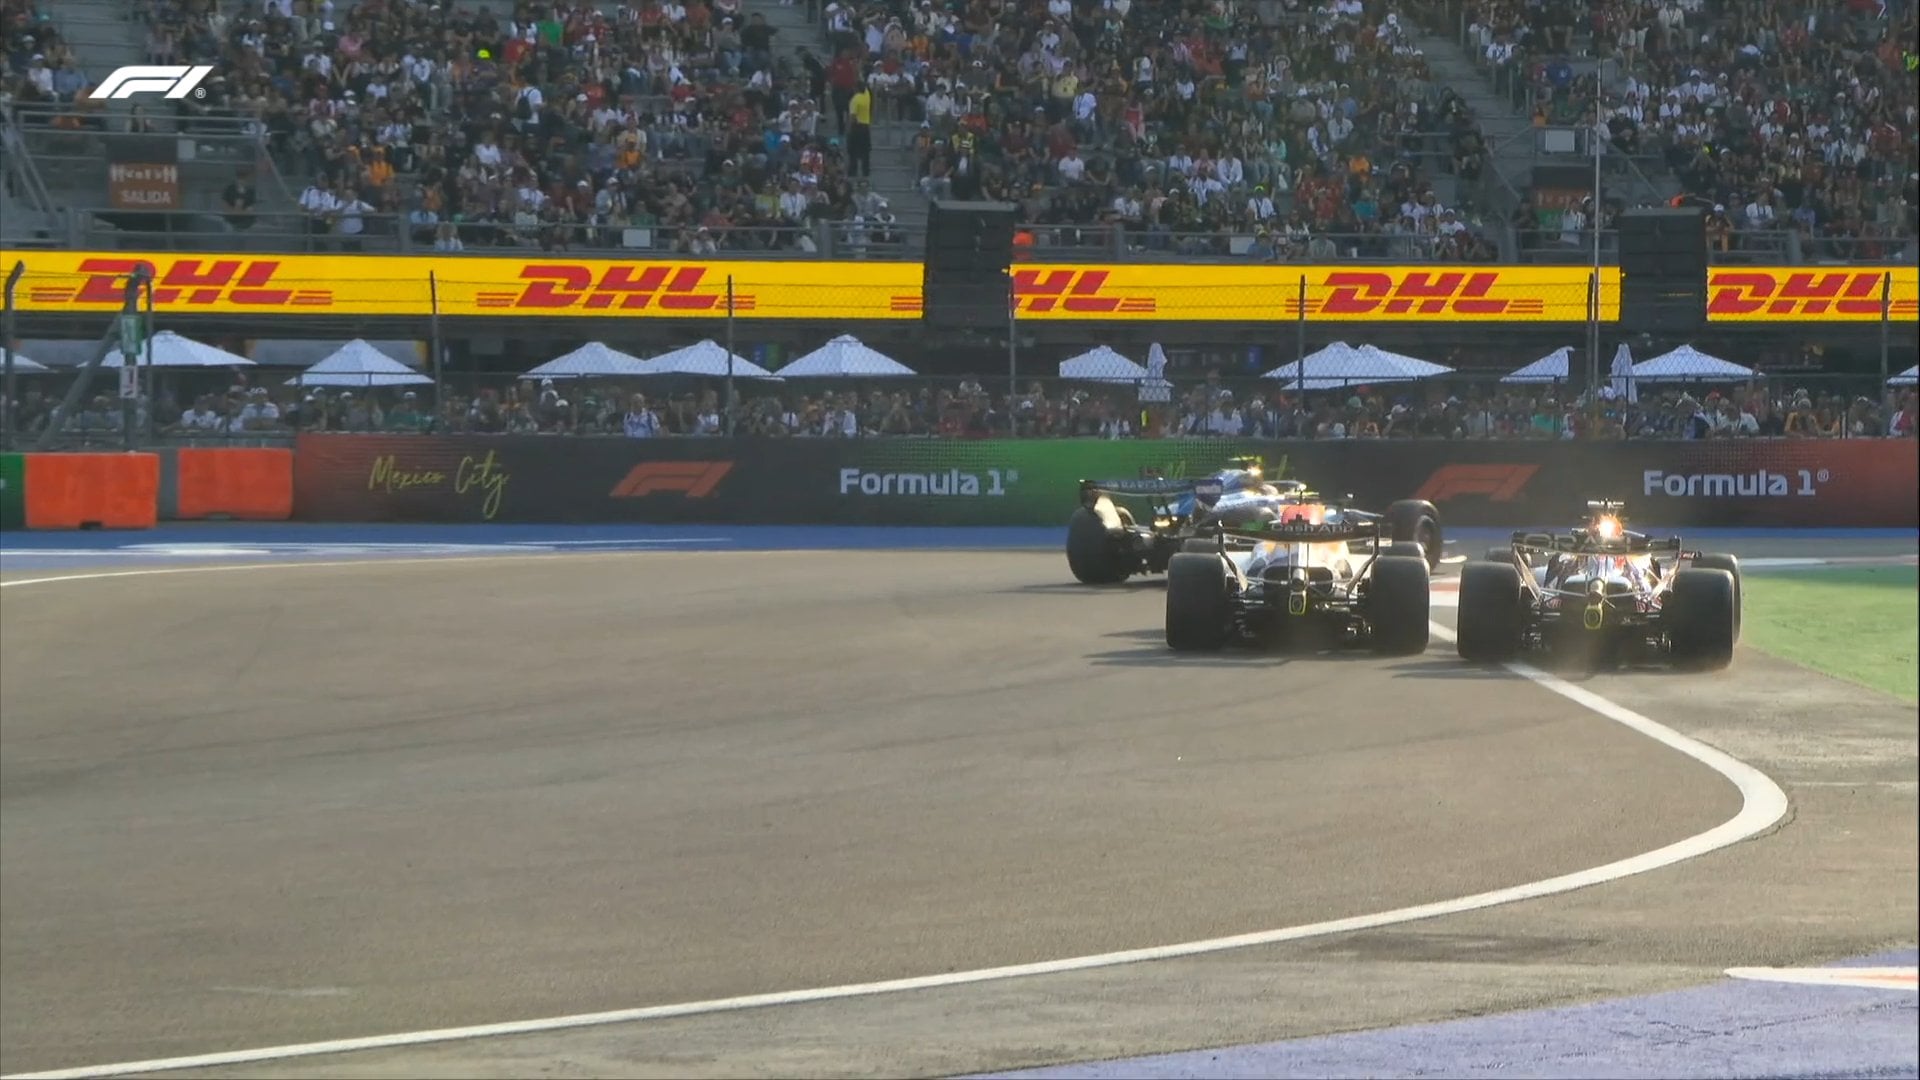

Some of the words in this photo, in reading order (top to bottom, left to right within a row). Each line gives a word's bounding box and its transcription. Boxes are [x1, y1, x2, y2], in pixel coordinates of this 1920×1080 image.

[74, 258, 292, 305] DHL
[515, 265, 719, 309] DHL
[1012, 270, 1122, 312] HL
[1320, 272, 1509, 313] DHL
[1708, 273, 1884, 313] DHL
[368, 455, 443, 493] Mexico
[455, 450, 509, 519] City
[839, 468, 979, 496] Formula
[1643, 470, 1788, 496] Formula
